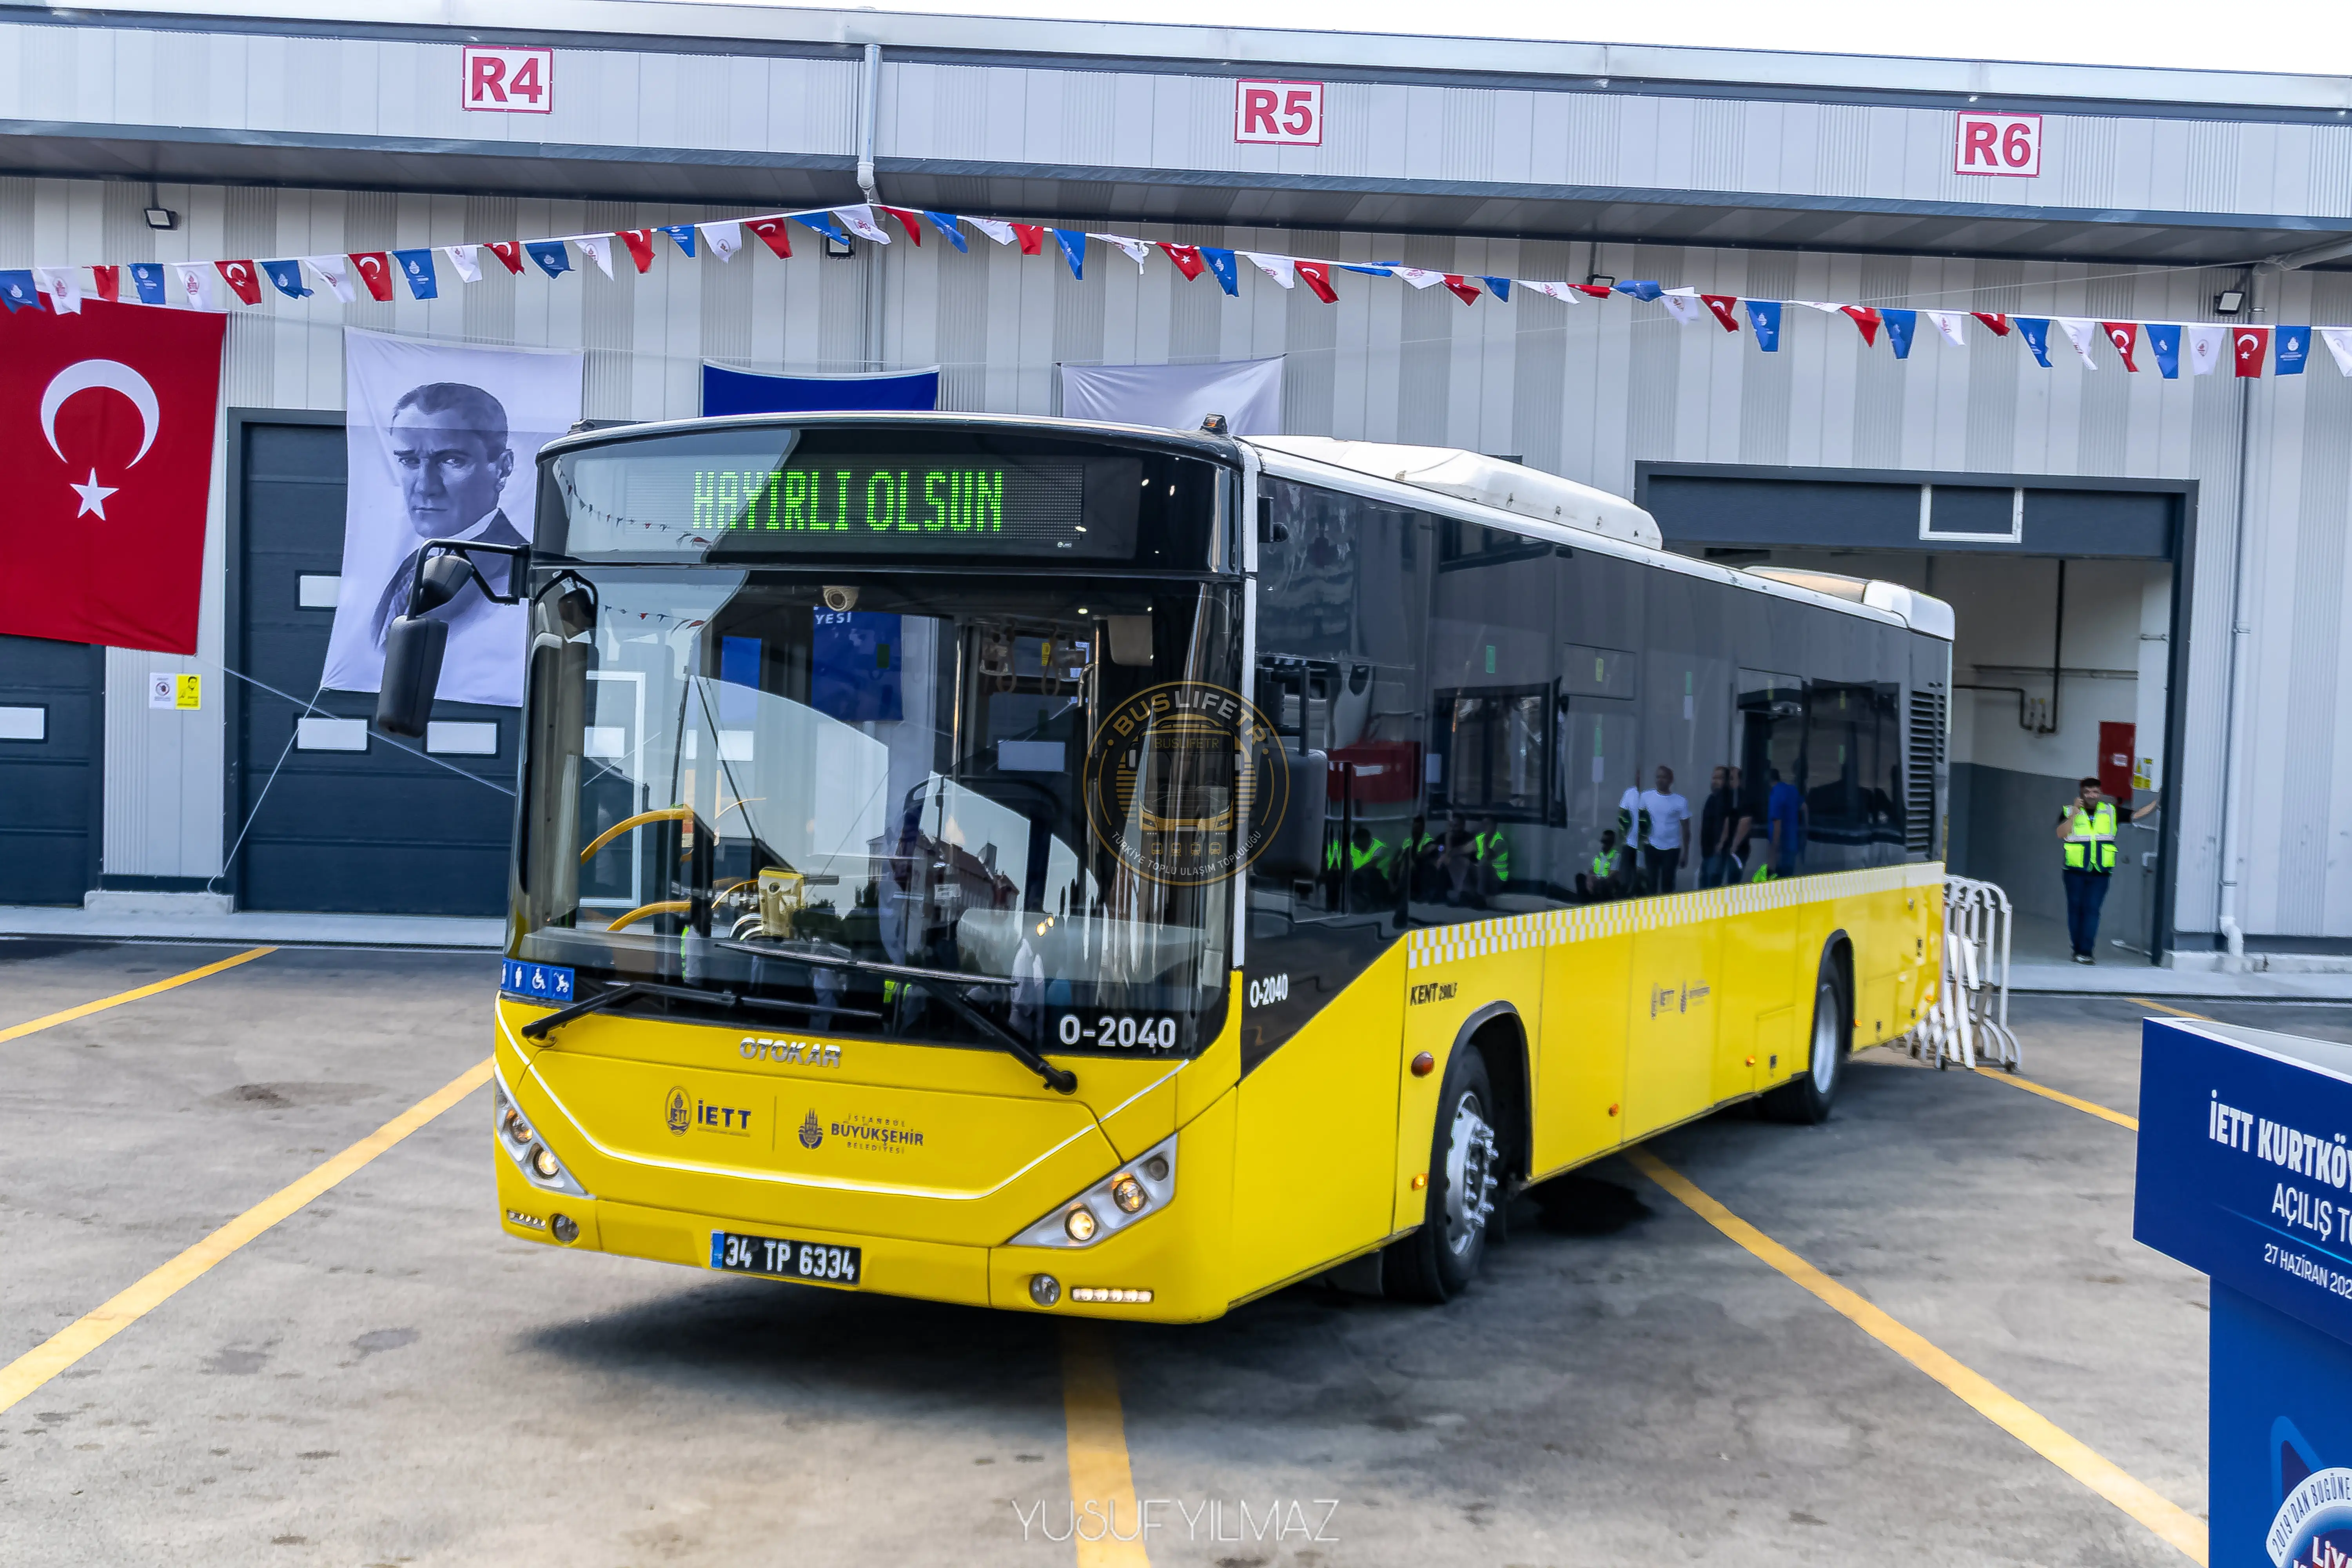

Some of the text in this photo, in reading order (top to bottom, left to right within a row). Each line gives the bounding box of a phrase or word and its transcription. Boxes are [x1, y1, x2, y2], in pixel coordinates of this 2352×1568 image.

[472, 56, 543, 103] R4
[1245, 89, 1312, 136] R5
[1964, 122, 2031, 168] R6
[693, 471, 1002, 532] HAYIRLI OLSUN
[1410, 982, 1438, 1006] KENT
[739, 1037, 842, 1068] OTOKAR
[697, 1098, 751, 1129] İETT
[2209, 1089, 2254, 1152] İETT
[2272, 1183, 2332, 1241] AÇILIŞ
[725, 1236, 855, 1280] 34 TP 6334
[2264, 1243, 2279, 1265] 27
[2280, 1250, 2328, 1288] HAZİRAN
